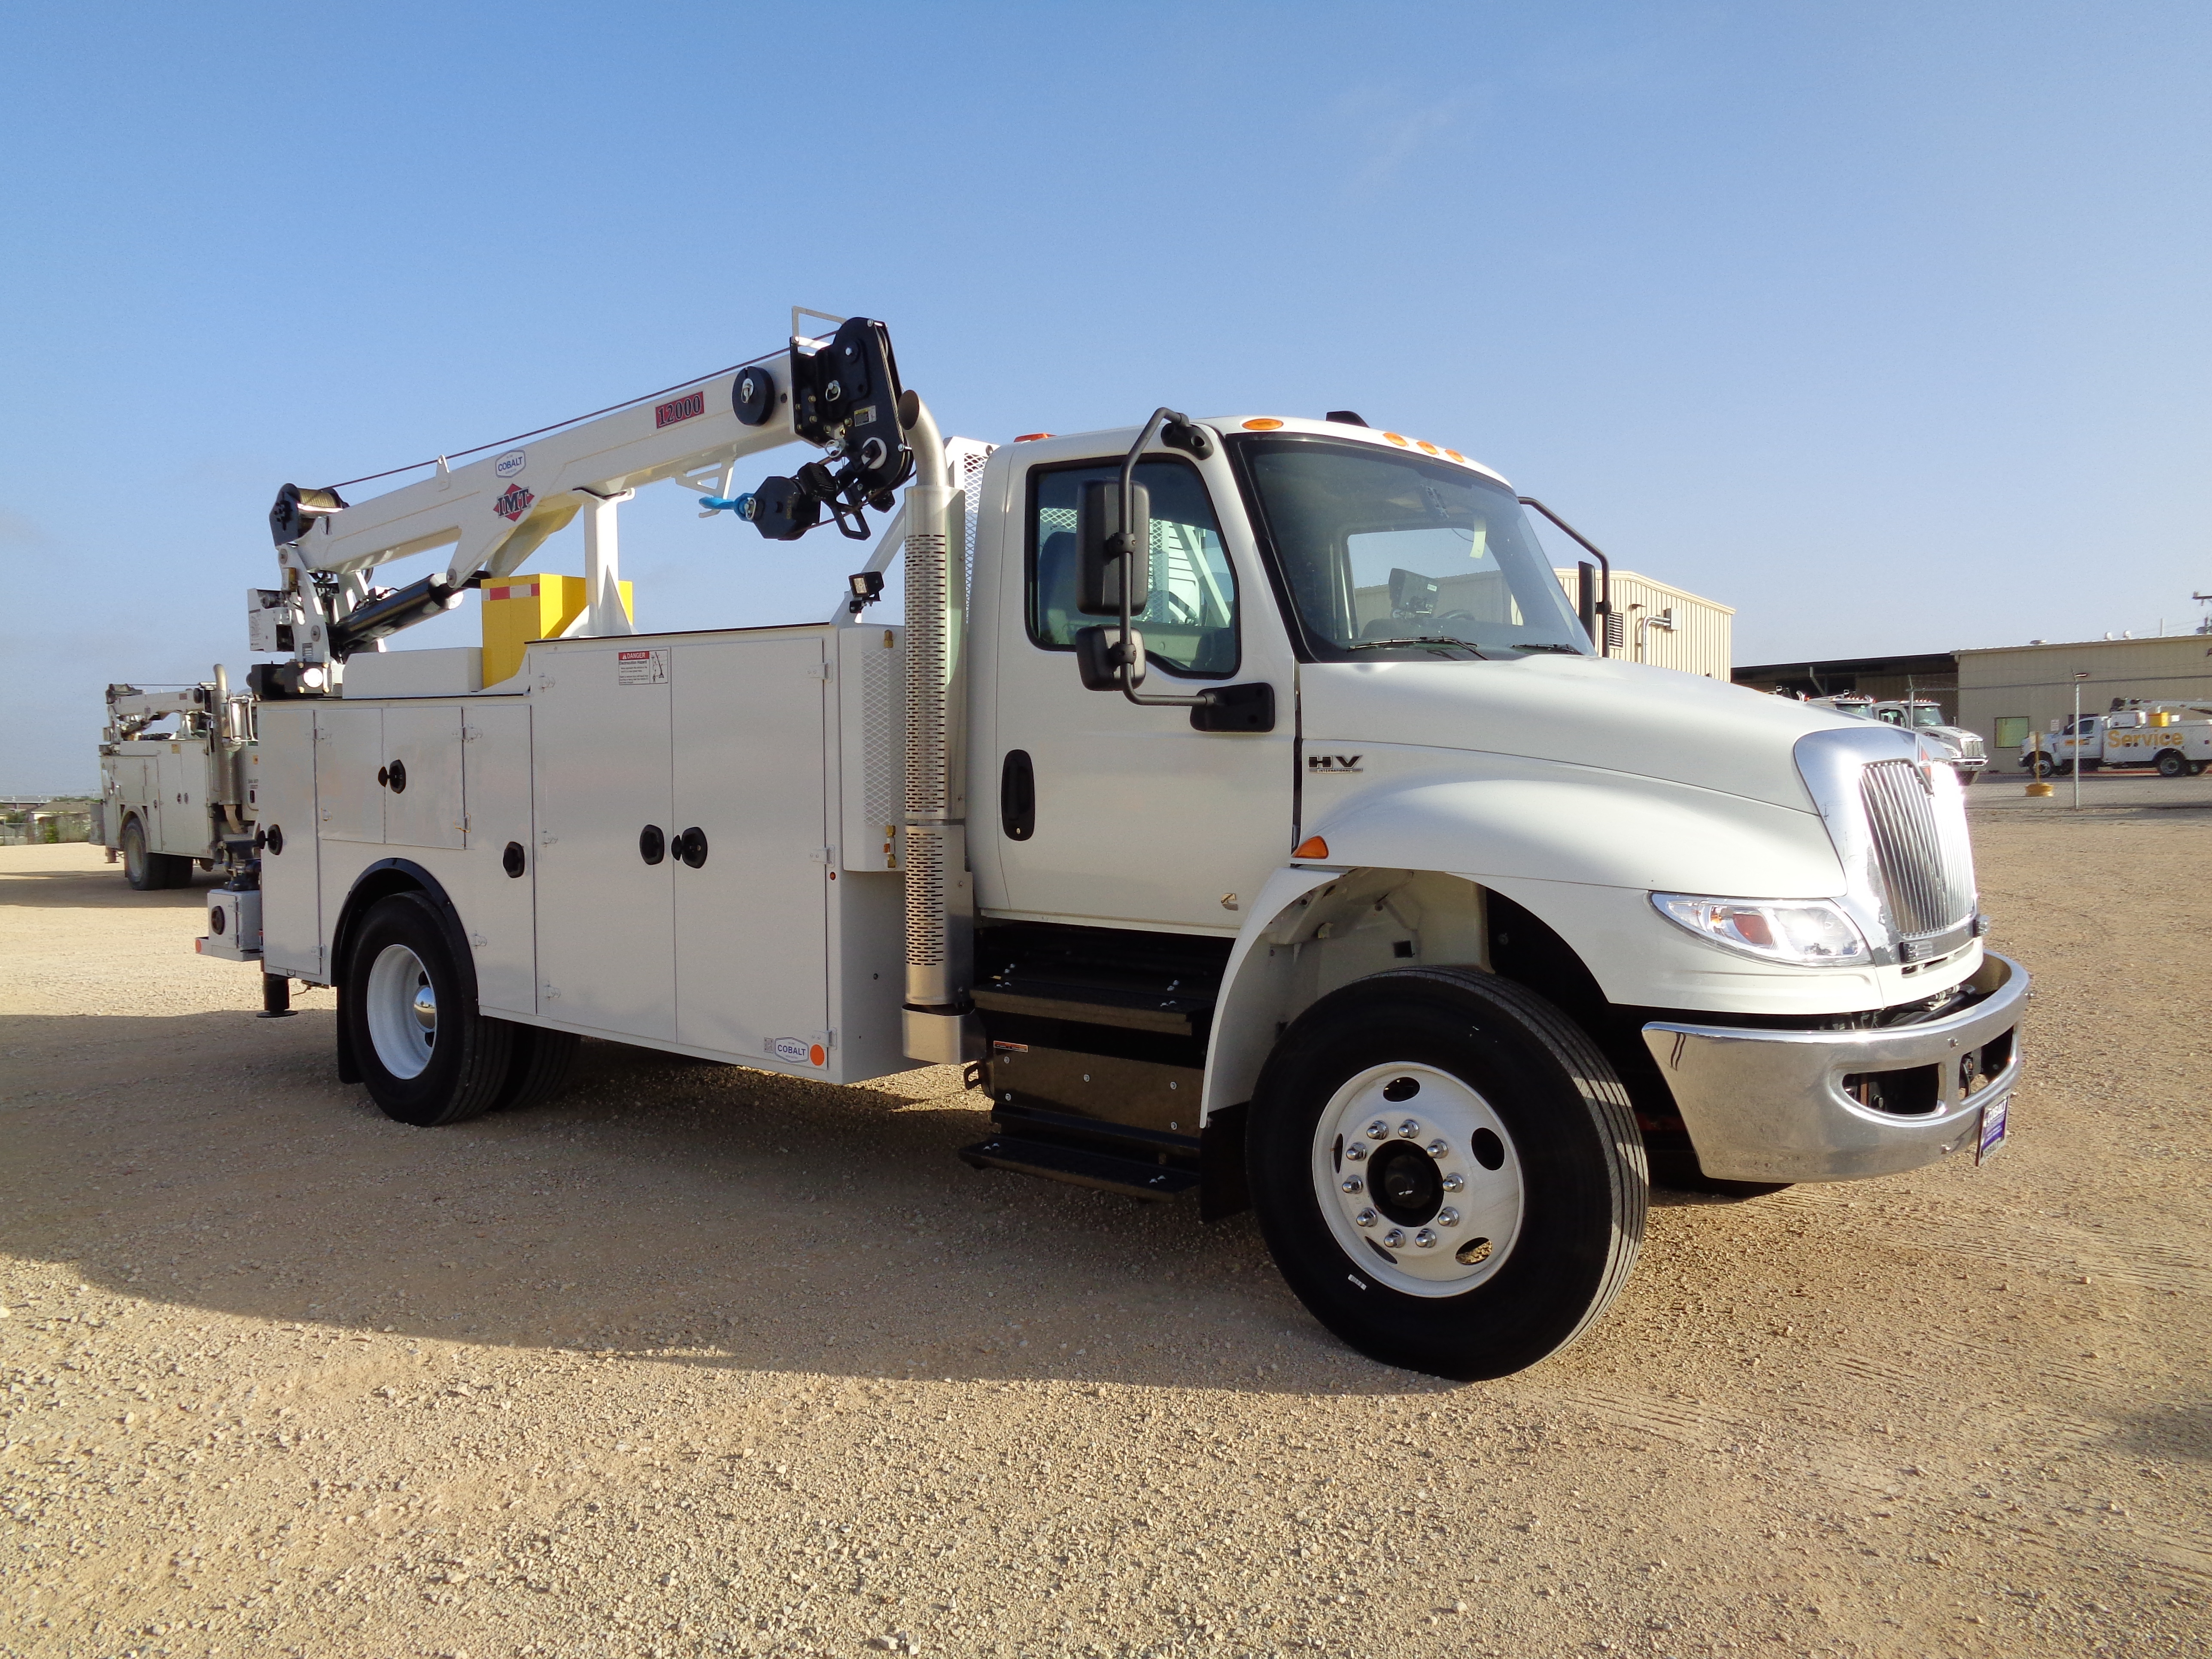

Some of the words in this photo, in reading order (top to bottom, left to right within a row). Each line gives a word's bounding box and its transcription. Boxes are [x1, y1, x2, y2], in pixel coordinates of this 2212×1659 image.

[658, 395, 702, 426] 12000
[498, 456, 523, 471] COBALT
[497, 486, 530, 518] IMT
[2108, 729, 2184, 748] Service
[1309, 755, 1363, 768] HV
[777, 1044, 806, 1056] COBALT
